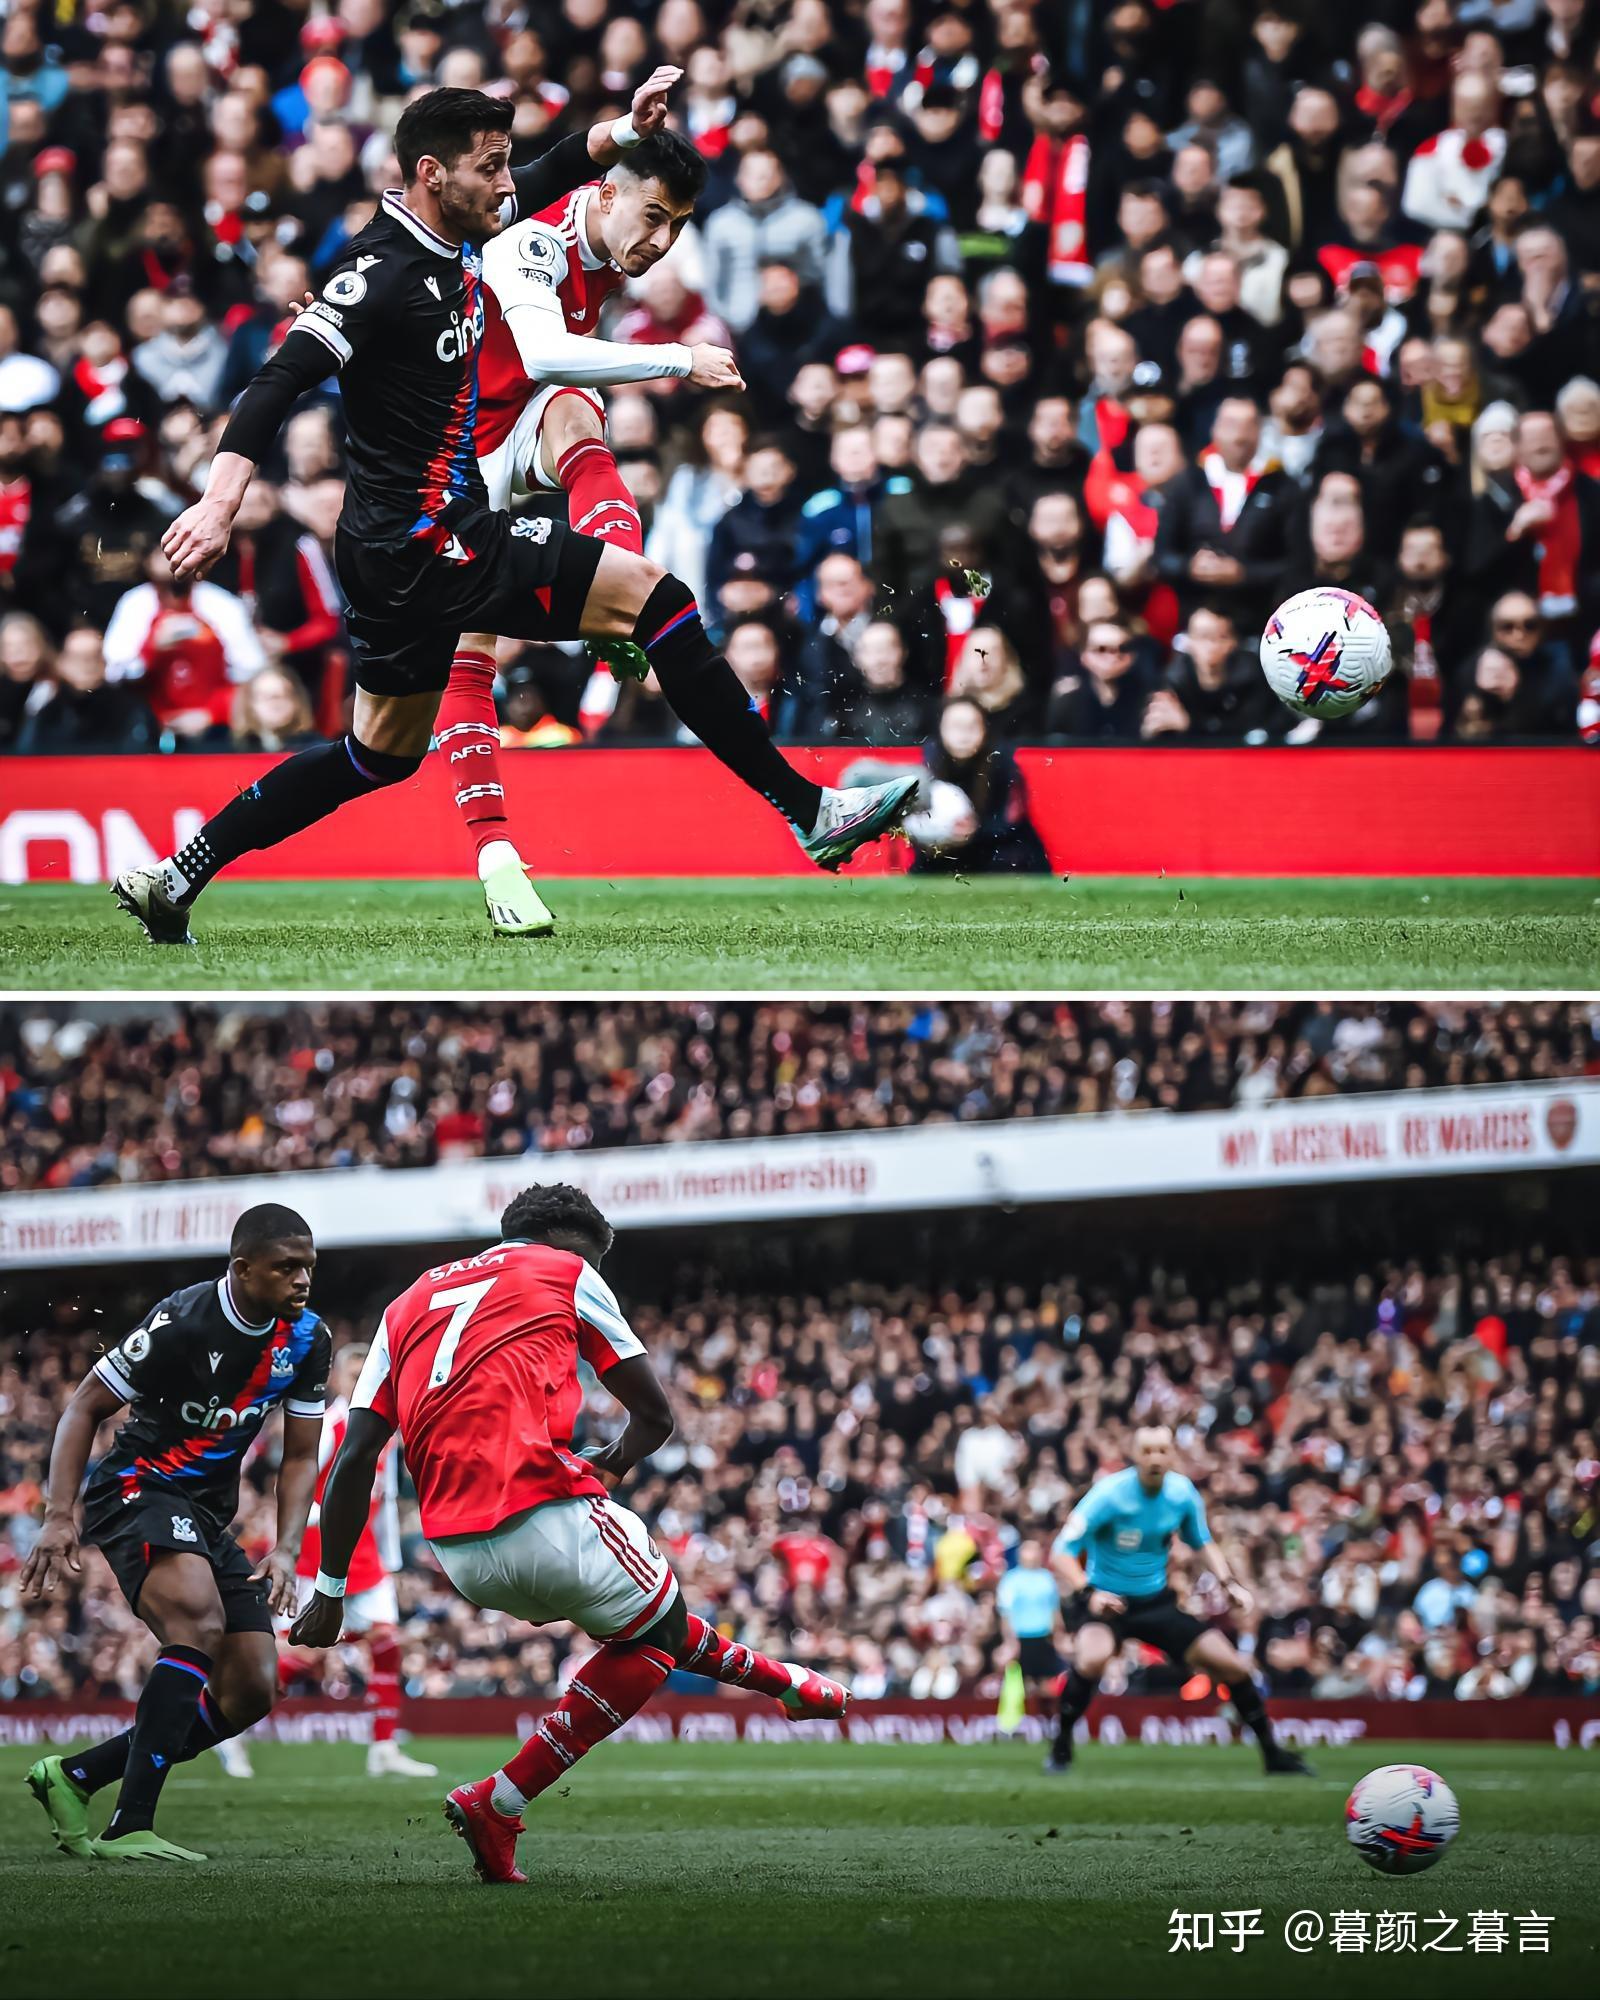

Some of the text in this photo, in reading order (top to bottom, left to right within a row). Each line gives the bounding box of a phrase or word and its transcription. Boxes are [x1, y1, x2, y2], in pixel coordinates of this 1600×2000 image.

[593, 519, 633, 538] AFC
[450, 744, 492, 764] AFC
[428, 1252, 508, 1283] SAKA
[427, 1275, 499, 1390] 7
